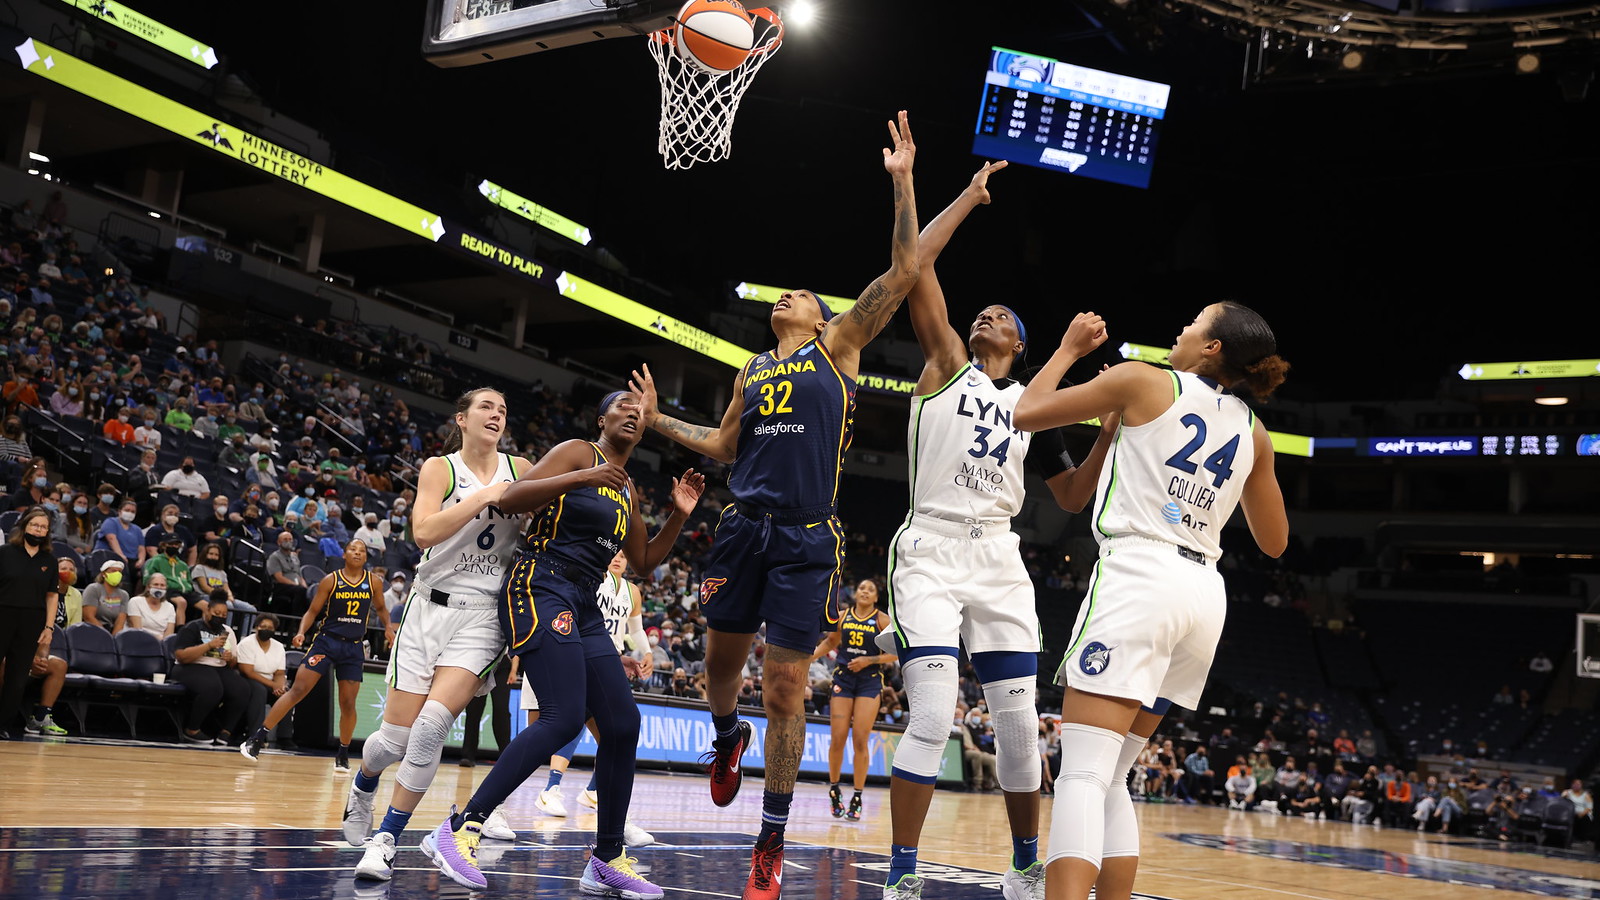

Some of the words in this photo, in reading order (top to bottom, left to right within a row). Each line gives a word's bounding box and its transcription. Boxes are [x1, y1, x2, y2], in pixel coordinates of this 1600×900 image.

[240, 147, 310, 186] LOTTERY
[242, 133, 323, 177] MINNESOTA
[460, 232, 498, 260] READY
[497, 248, 512, 266] TO
[512, 255, 544, 280] PLAY?
[745, 359, 817, 389] INDIANA
[868, 376, 884, 389] TO
[759, 380, 793, 416] 32
[754, 421, 805, 436] salesforce
[967, 424, 1011, 468] 34
[1164, 412, 1241, 490] 24
[1415, 441, 1453, 455] TAME
[1452, 440, 1473, 452] US
[961, 461, 1004, 485] MAYO
[597, 486, 630, 519] INDIA
[1167, 475, 1216, 512] COLLIER
[613, 508, 627, 541] 14
[1181, 513, 1208, 532] AT
[476, 523, 496, 551] 6
[454, 563, 501, 577] CLINIC
[460, 552, 499, 565] MAYO
[335, 591, 370, 600] INDIANA
[346, 600, 360, 616] 12
[604, 618, 620, 636] 21
[842, 622, 876, 633] INDIANA
[848, 630, 864, 647] 35
